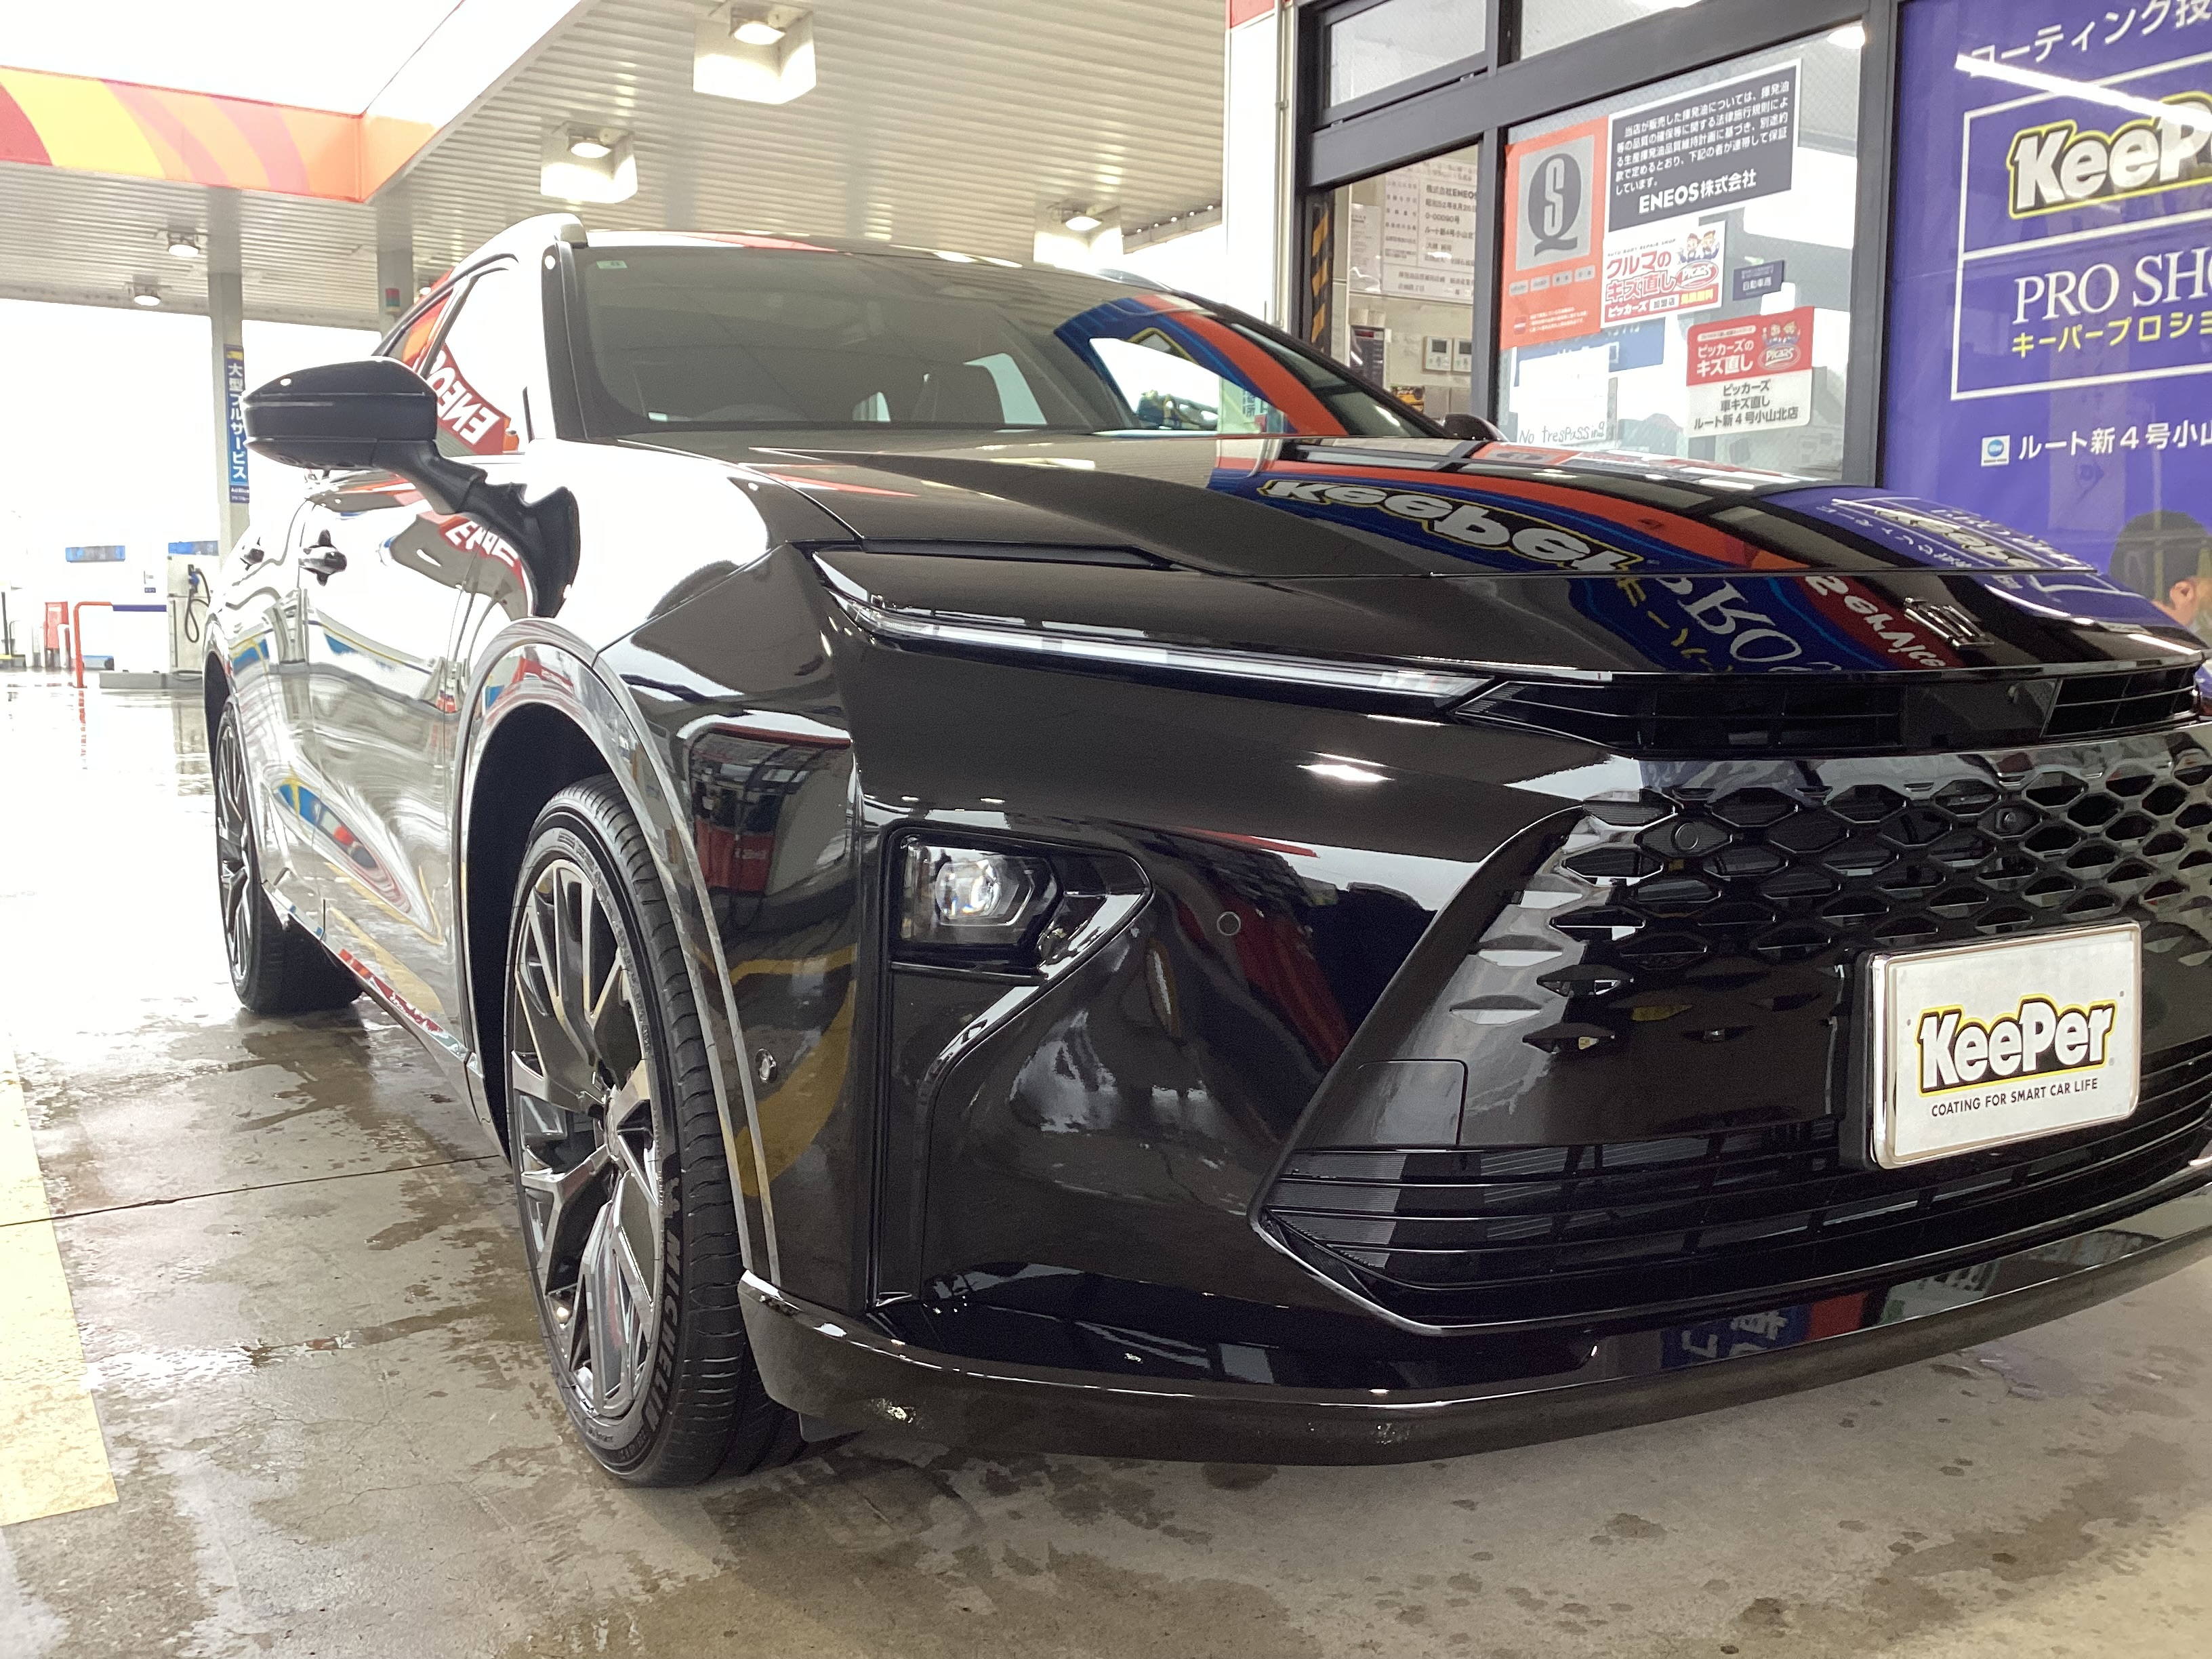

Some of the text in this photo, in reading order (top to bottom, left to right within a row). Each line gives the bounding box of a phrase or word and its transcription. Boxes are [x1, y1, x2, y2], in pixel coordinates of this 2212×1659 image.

[2010, 96, 2212, 216] KeeP
[1639, 168, 1757, 214] ENEOS株式会社
[1606, 250, 1672, 279] クルマの
[1605, 270, 1677, 303] キズ直し
[2012, 247, 2212, 325] PRO SH
[1607, 300, 1650, 318] ピッカーズ
[1698, 339, 1755, 359] ピッカーズの
[1696, 354, 1754, 377] キズ直し
[1723, 378, 1771, 396] ピッカーズ
[1720, 395, 1771, 413] 車キズ直し
[1519, 429, 1536, 445] No
[1917, 998, 2115, 1092] KeePer
[1931, 1077, 2099, 1117] COATING FOR SMART CAR LIFE
